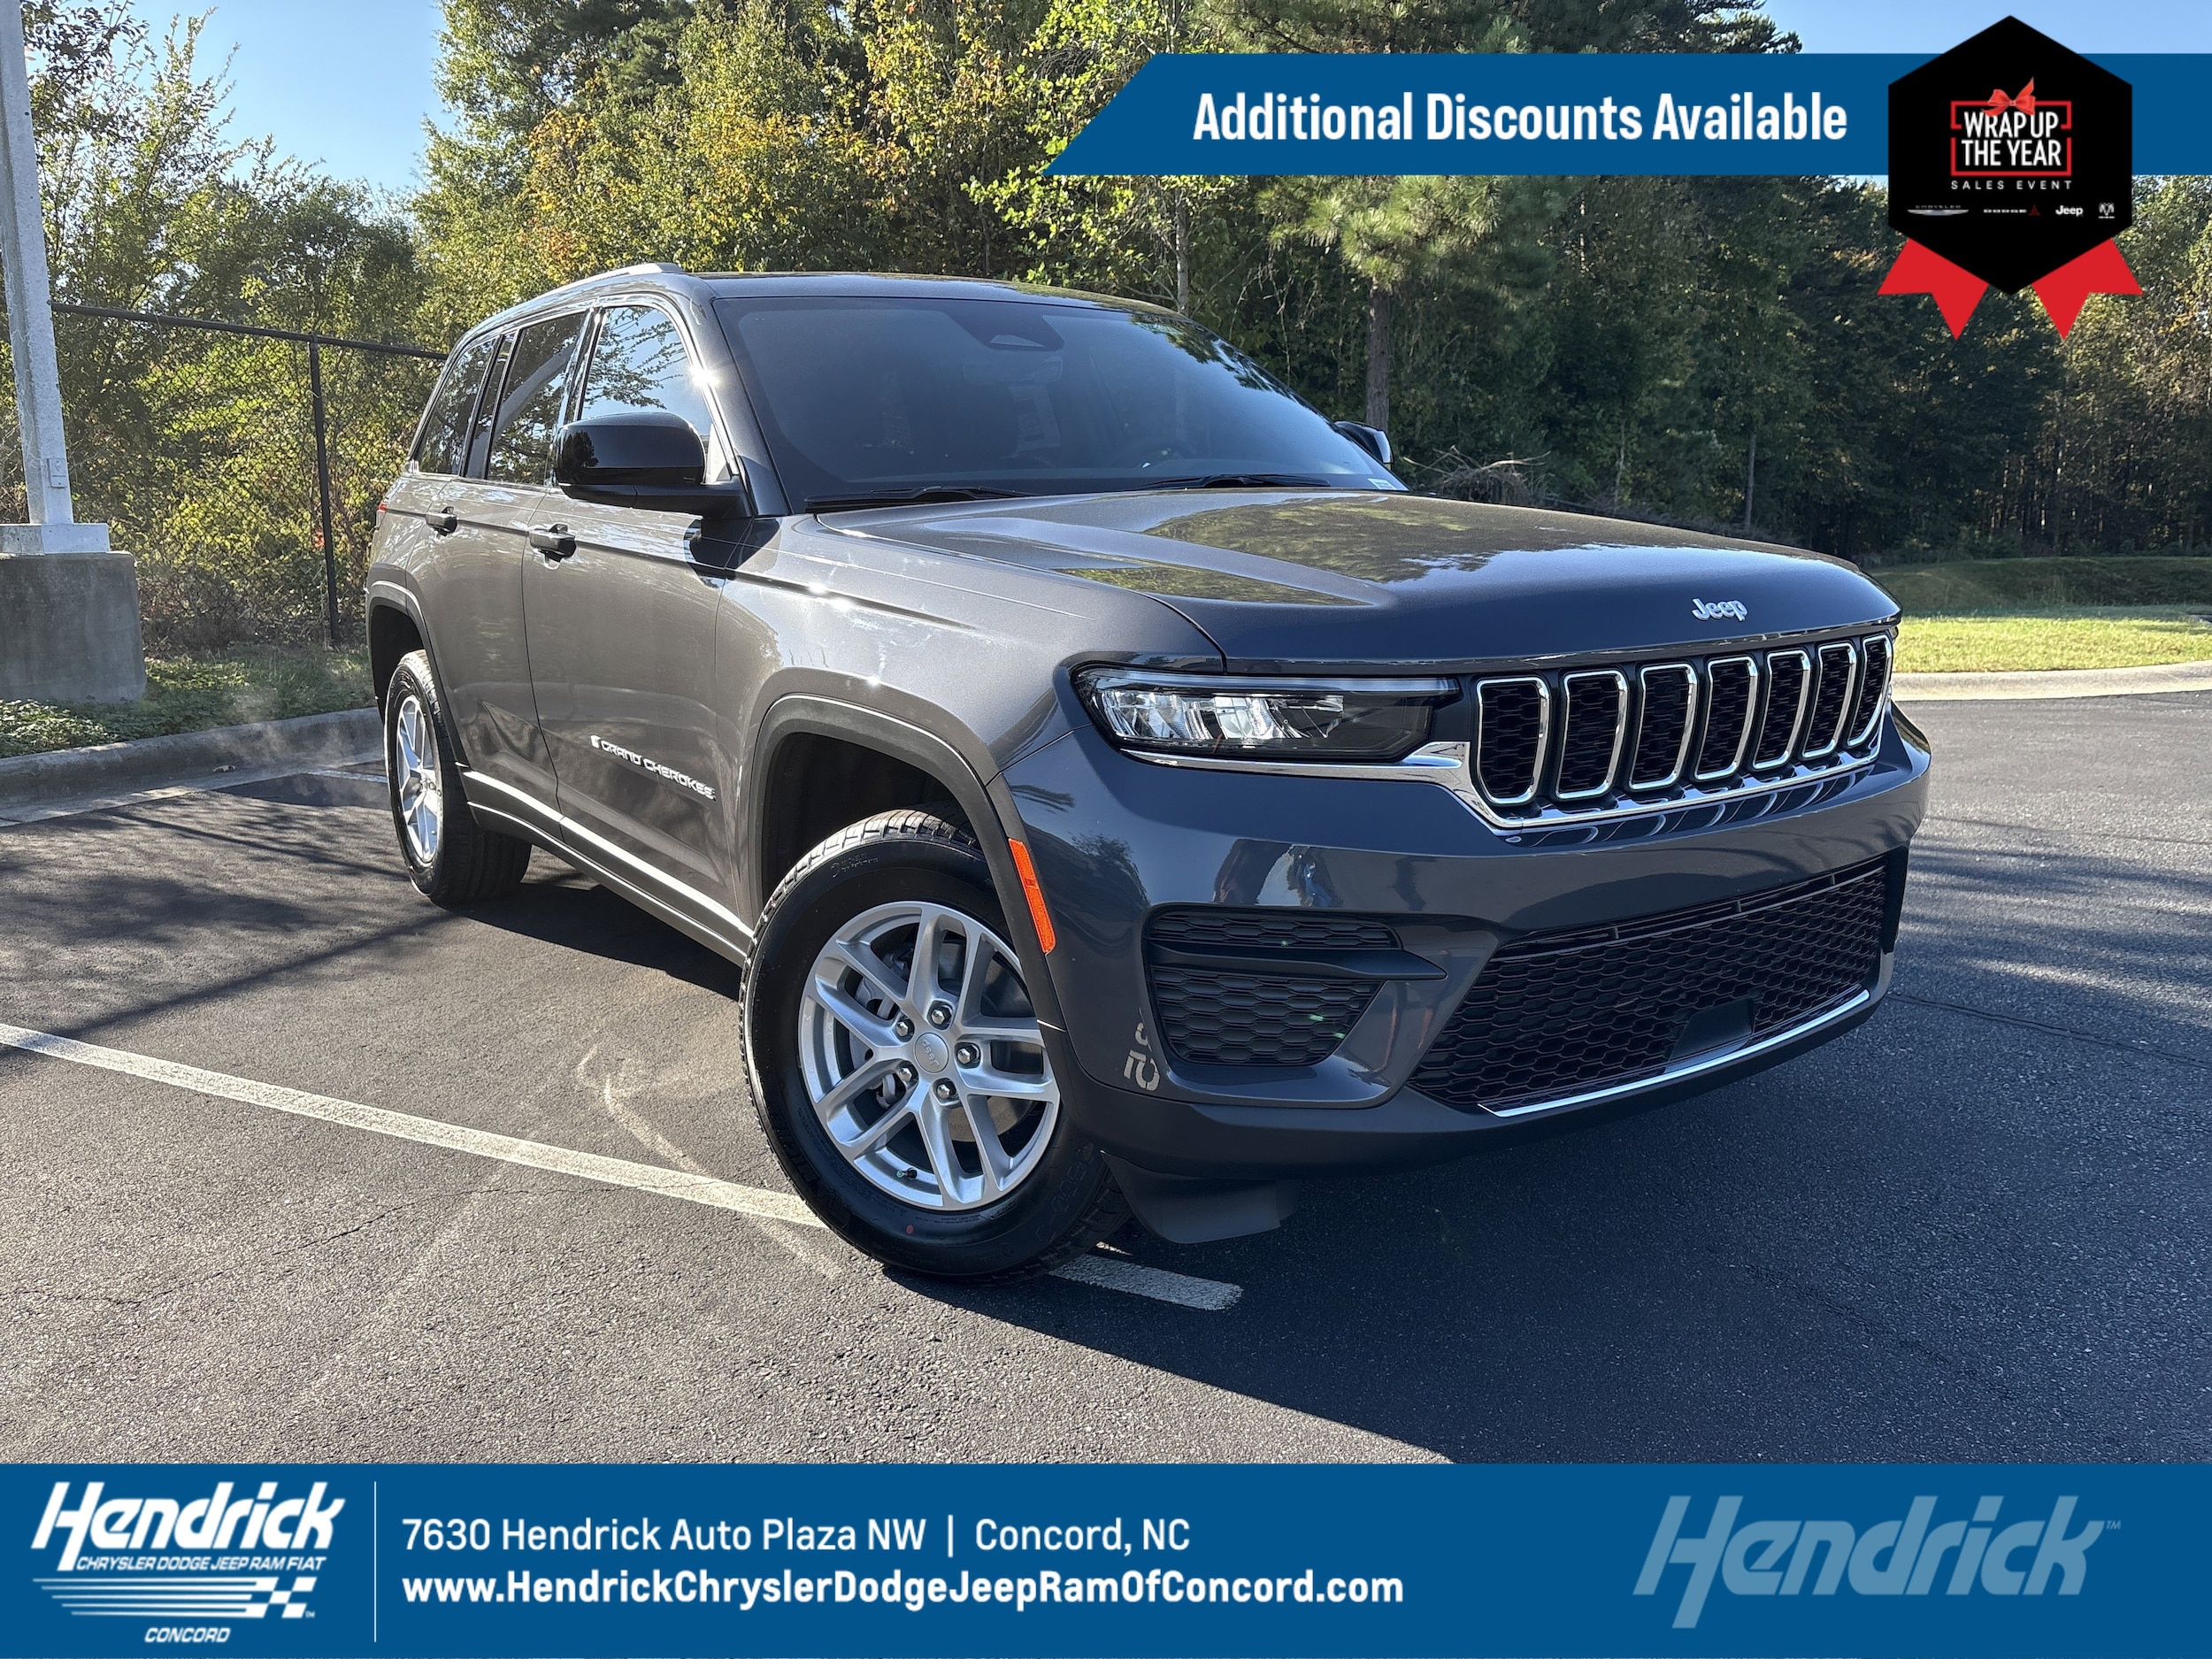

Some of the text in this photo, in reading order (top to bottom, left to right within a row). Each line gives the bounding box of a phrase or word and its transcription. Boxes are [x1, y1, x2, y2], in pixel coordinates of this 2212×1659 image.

[1691, 597, 1748, 622] Jeep
[601, 740, 716, 801] GRAND CHEROKEE
[921, 1039, 941, 1068] Jeep
